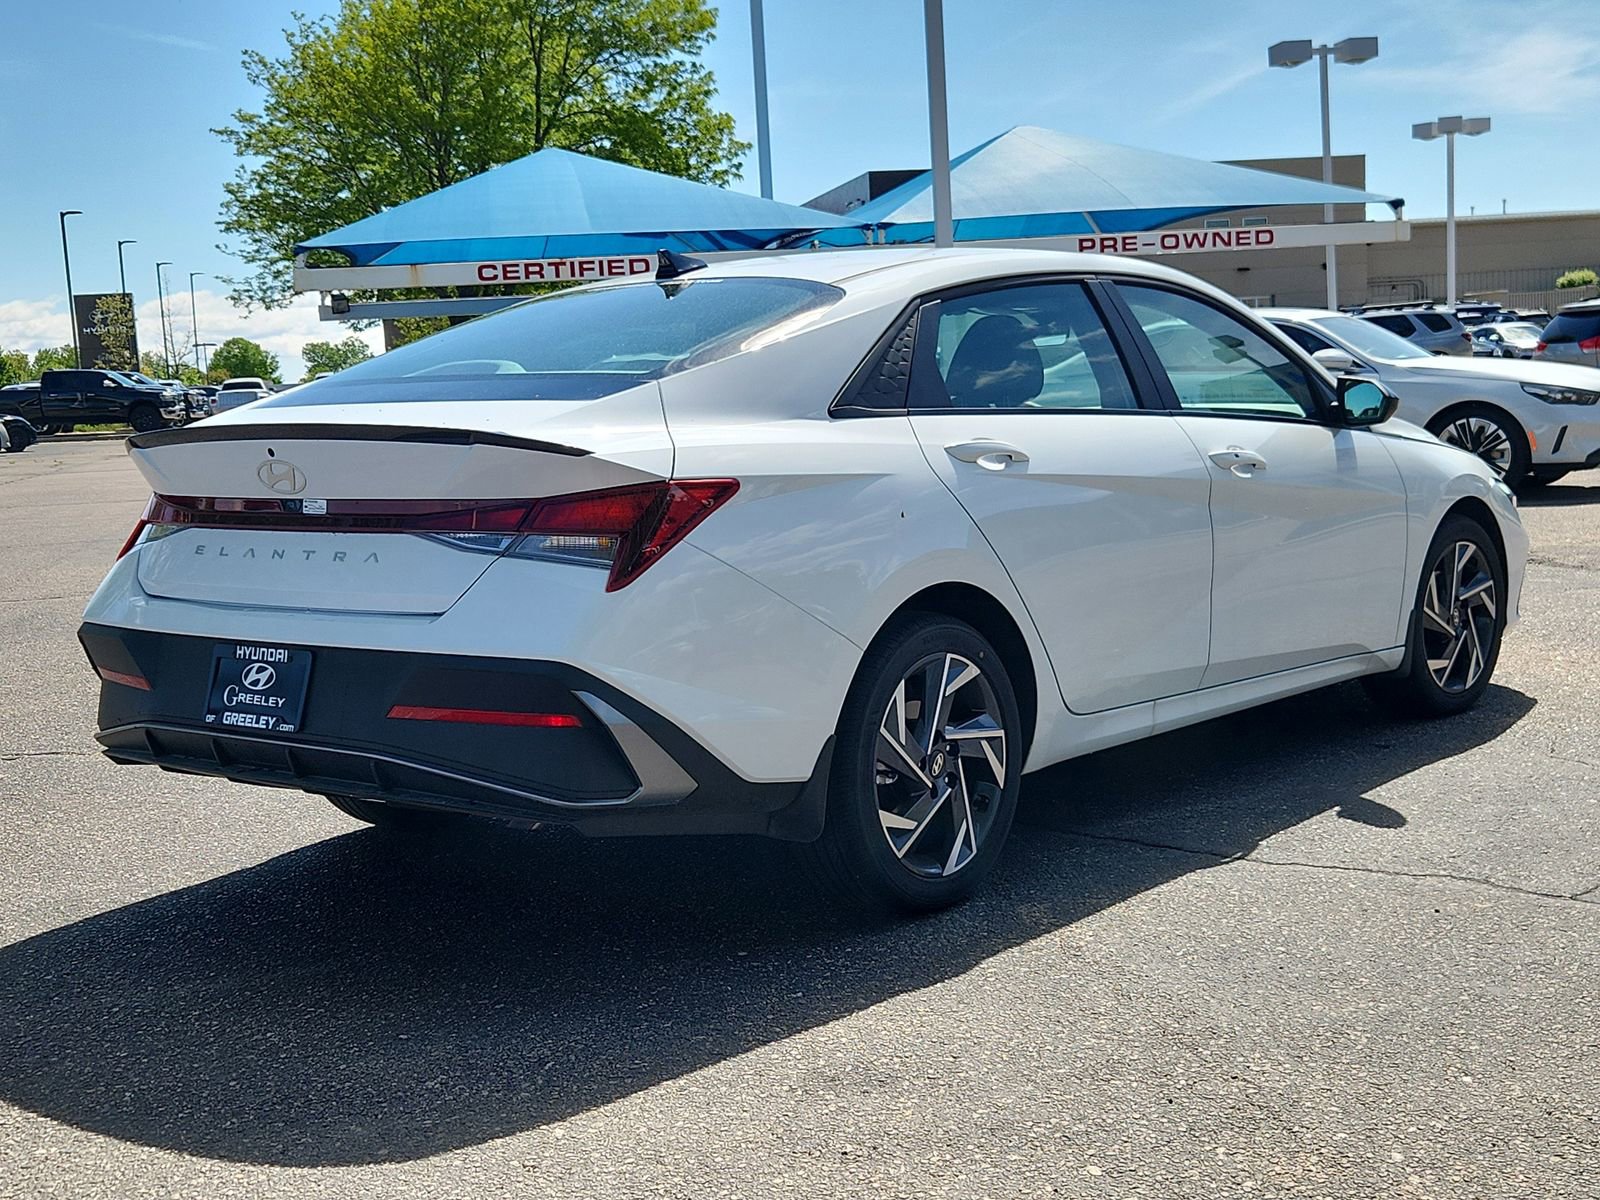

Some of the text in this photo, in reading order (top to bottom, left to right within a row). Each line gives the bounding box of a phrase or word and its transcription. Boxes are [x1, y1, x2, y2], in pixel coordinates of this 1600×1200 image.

[1078, 229, 1274, 252] PRE-OWNED
[477, 258, 650, 282] CERTIFIED
[194, 544, 380, 563] ELANTRA
[236, 645, 288, 663] HYUNDAI
[223, 684, 286, 708] GREELEY
[205, 714, 216, 723] OF
